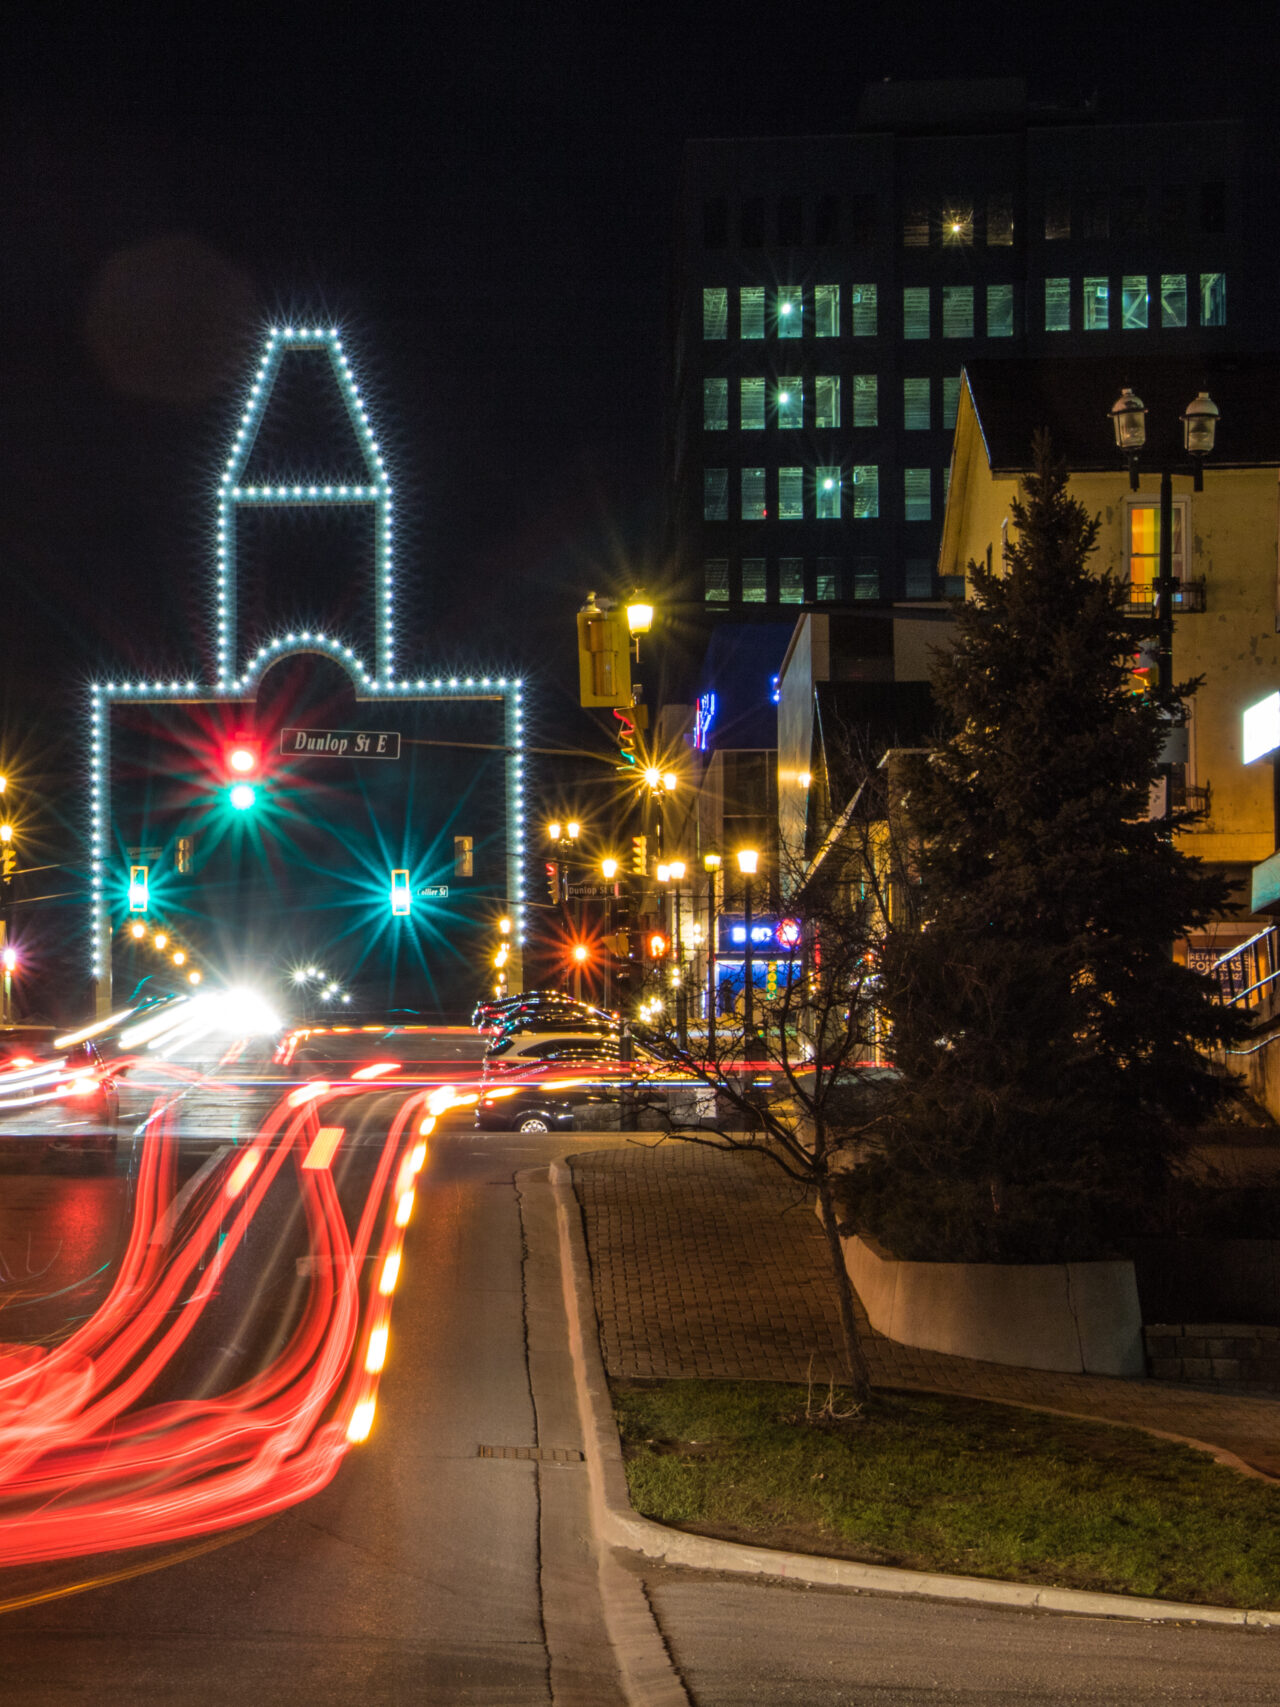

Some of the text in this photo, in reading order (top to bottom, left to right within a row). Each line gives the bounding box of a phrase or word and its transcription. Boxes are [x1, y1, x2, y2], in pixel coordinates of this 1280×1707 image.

[294, 731, 388, 755] Dunlop St E
[416, 887, 447, 897] Collier St
[569, 886, 597, 897] Dunlop
